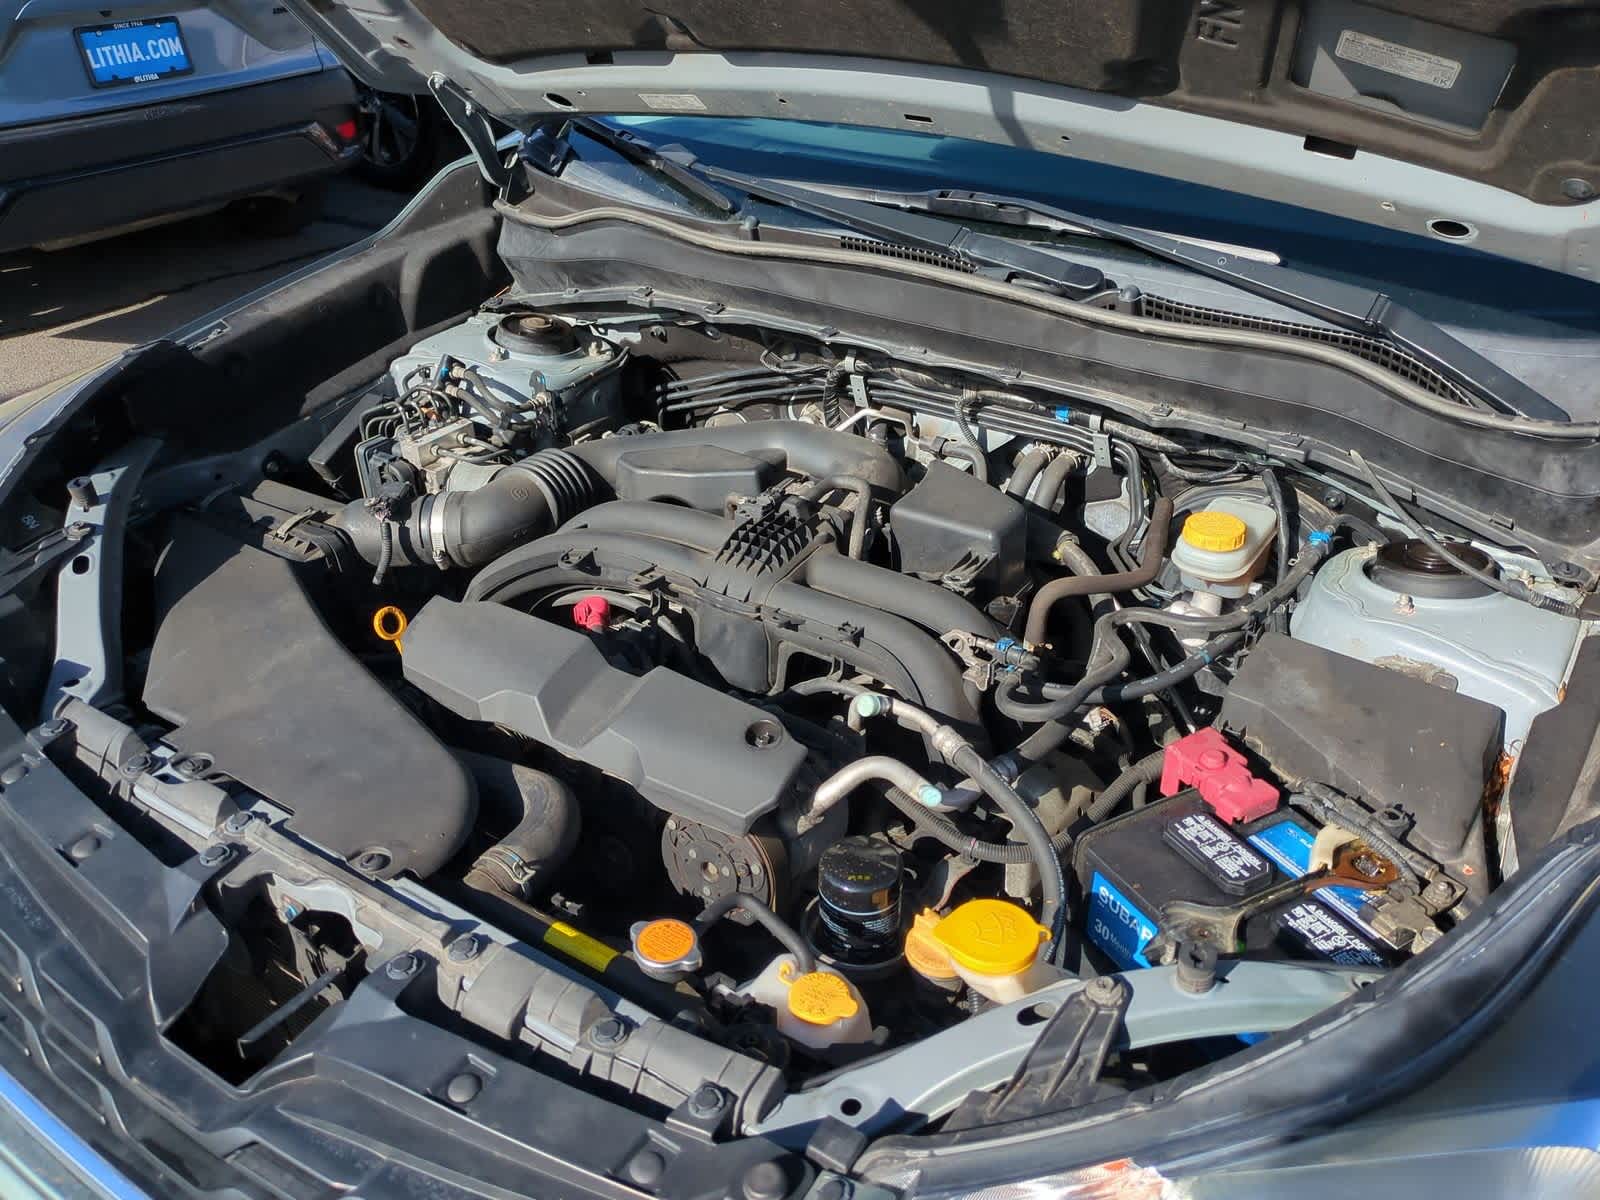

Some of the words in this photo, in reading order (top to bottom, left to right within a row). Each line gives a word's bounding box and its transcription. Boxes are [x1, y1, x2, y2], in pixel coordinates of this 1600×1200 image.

[86, 36, 184, 69] LITHIA.COM
[1094, 918, 1110, 941] 30
[1099, 885, 1153, 941] SUBAR
